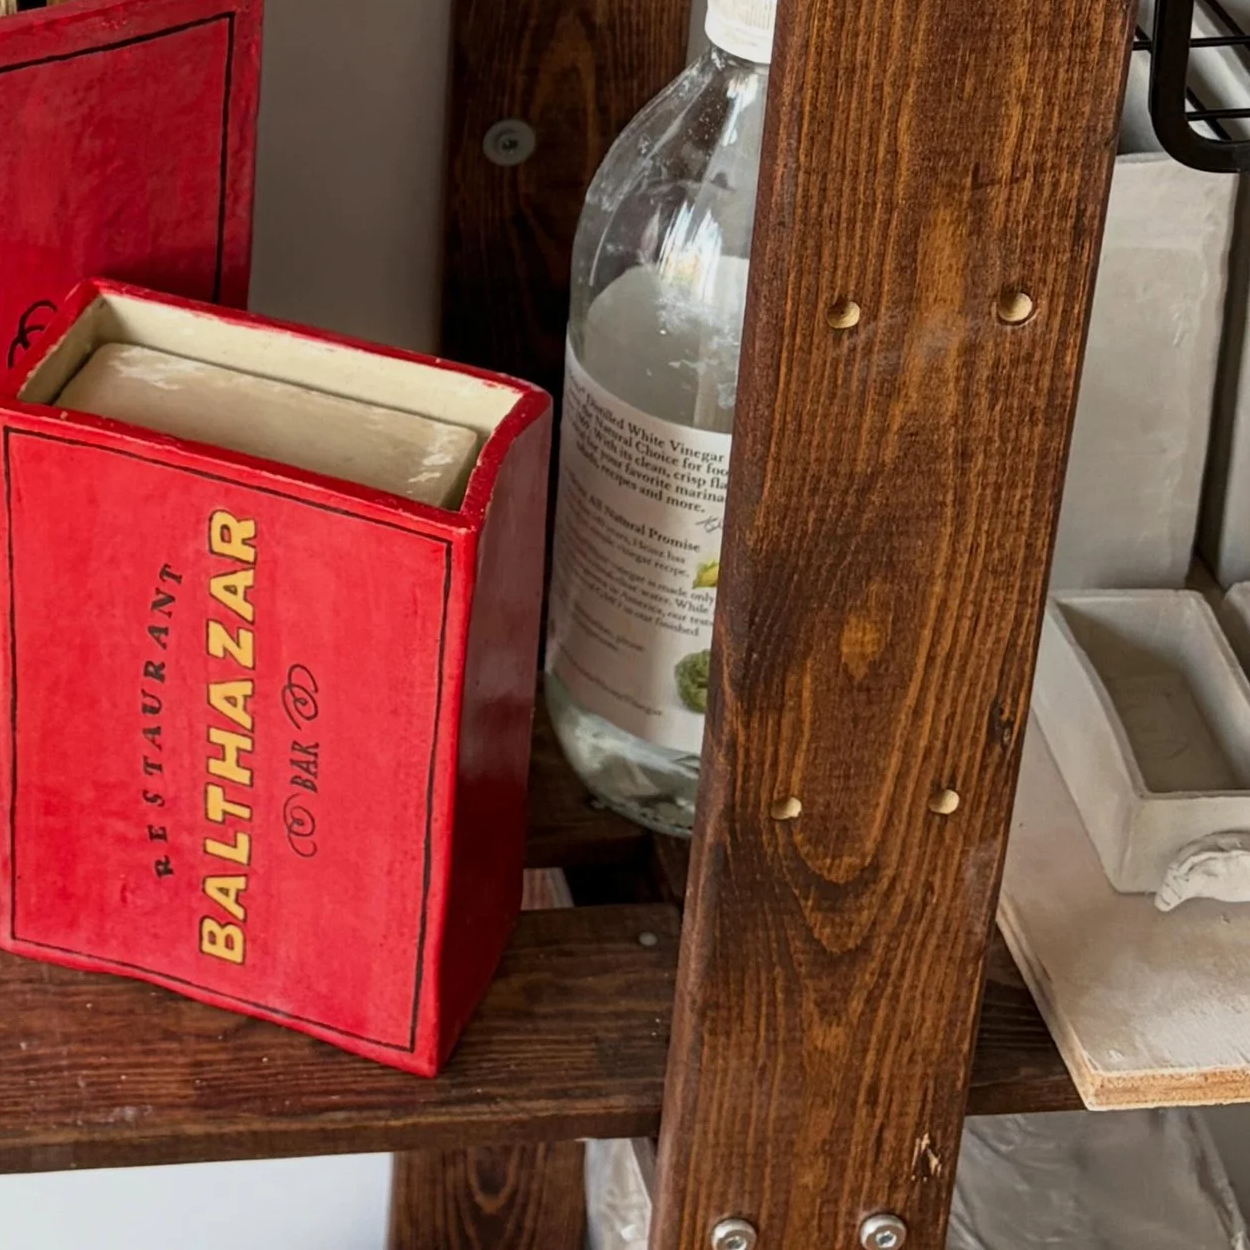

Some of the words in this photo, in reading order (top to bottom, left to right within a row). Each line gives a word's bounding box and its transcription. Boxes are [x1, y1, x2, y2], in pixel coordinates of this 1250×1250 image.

[628, 422, 666, 449] White
[670, 439, 725, 465] Vinegar
[635, 440, 679, 467] Choice
[683, 457, 703, 473] for
[625, 462, 672, 492] favorite
[635, 455, 671, 479] clean,
[673, 468, 706, 490] crisp
[639, 485, 664, 502] and
[666, 494, 706, 513] more.
[648, 527, 701, 553] Promise
[141, 562, 183, 879] RESTAURANT
[199, 507, 258, 966] BALTHAZAR
[290, 739, 320, 795] BAR
